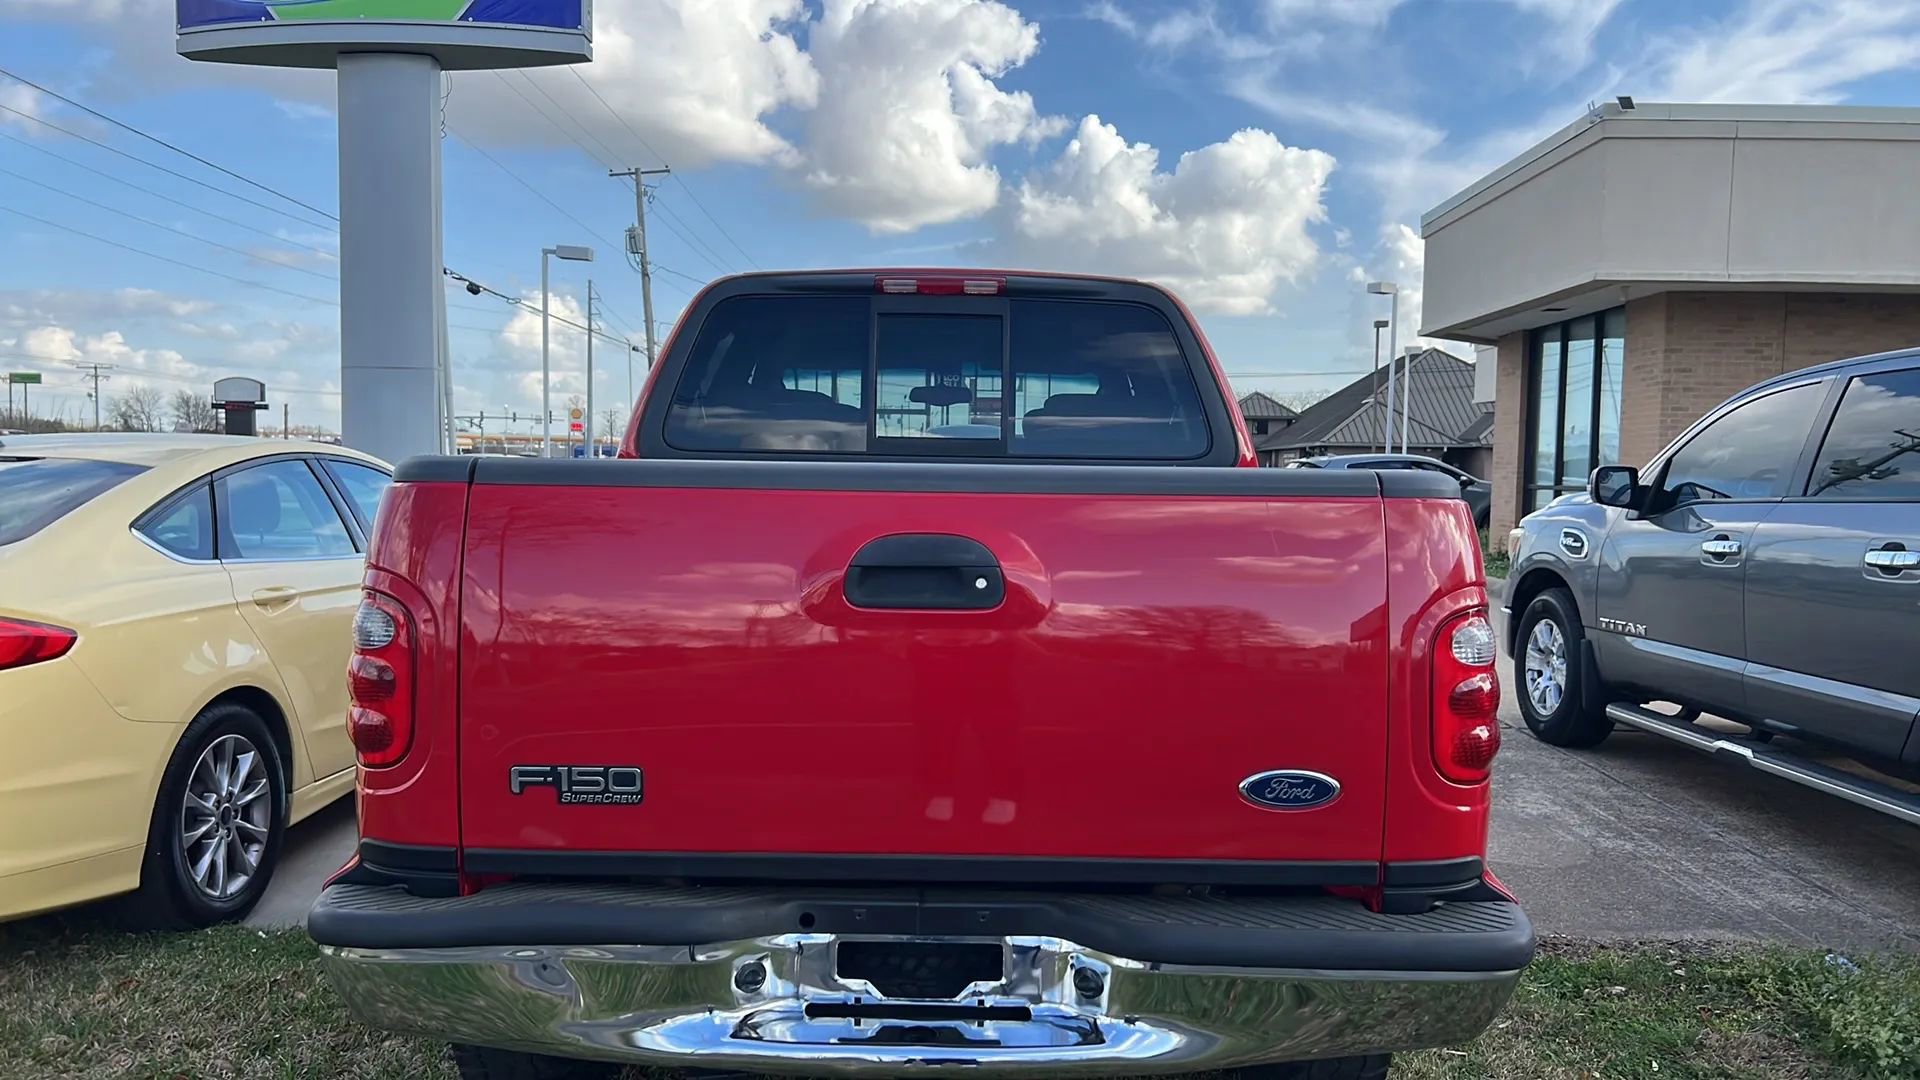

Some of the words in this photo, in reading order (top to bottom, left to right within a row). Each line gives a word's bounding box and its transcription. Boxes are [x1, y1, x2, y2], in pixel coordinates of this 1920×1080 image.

[1599, 617, 1647, 636] TITAN
[510, 766, 642, 794] F-150
[1264, 777, 1316, 800] Ford
[561, 793, 641, 803] SUPERCREW
